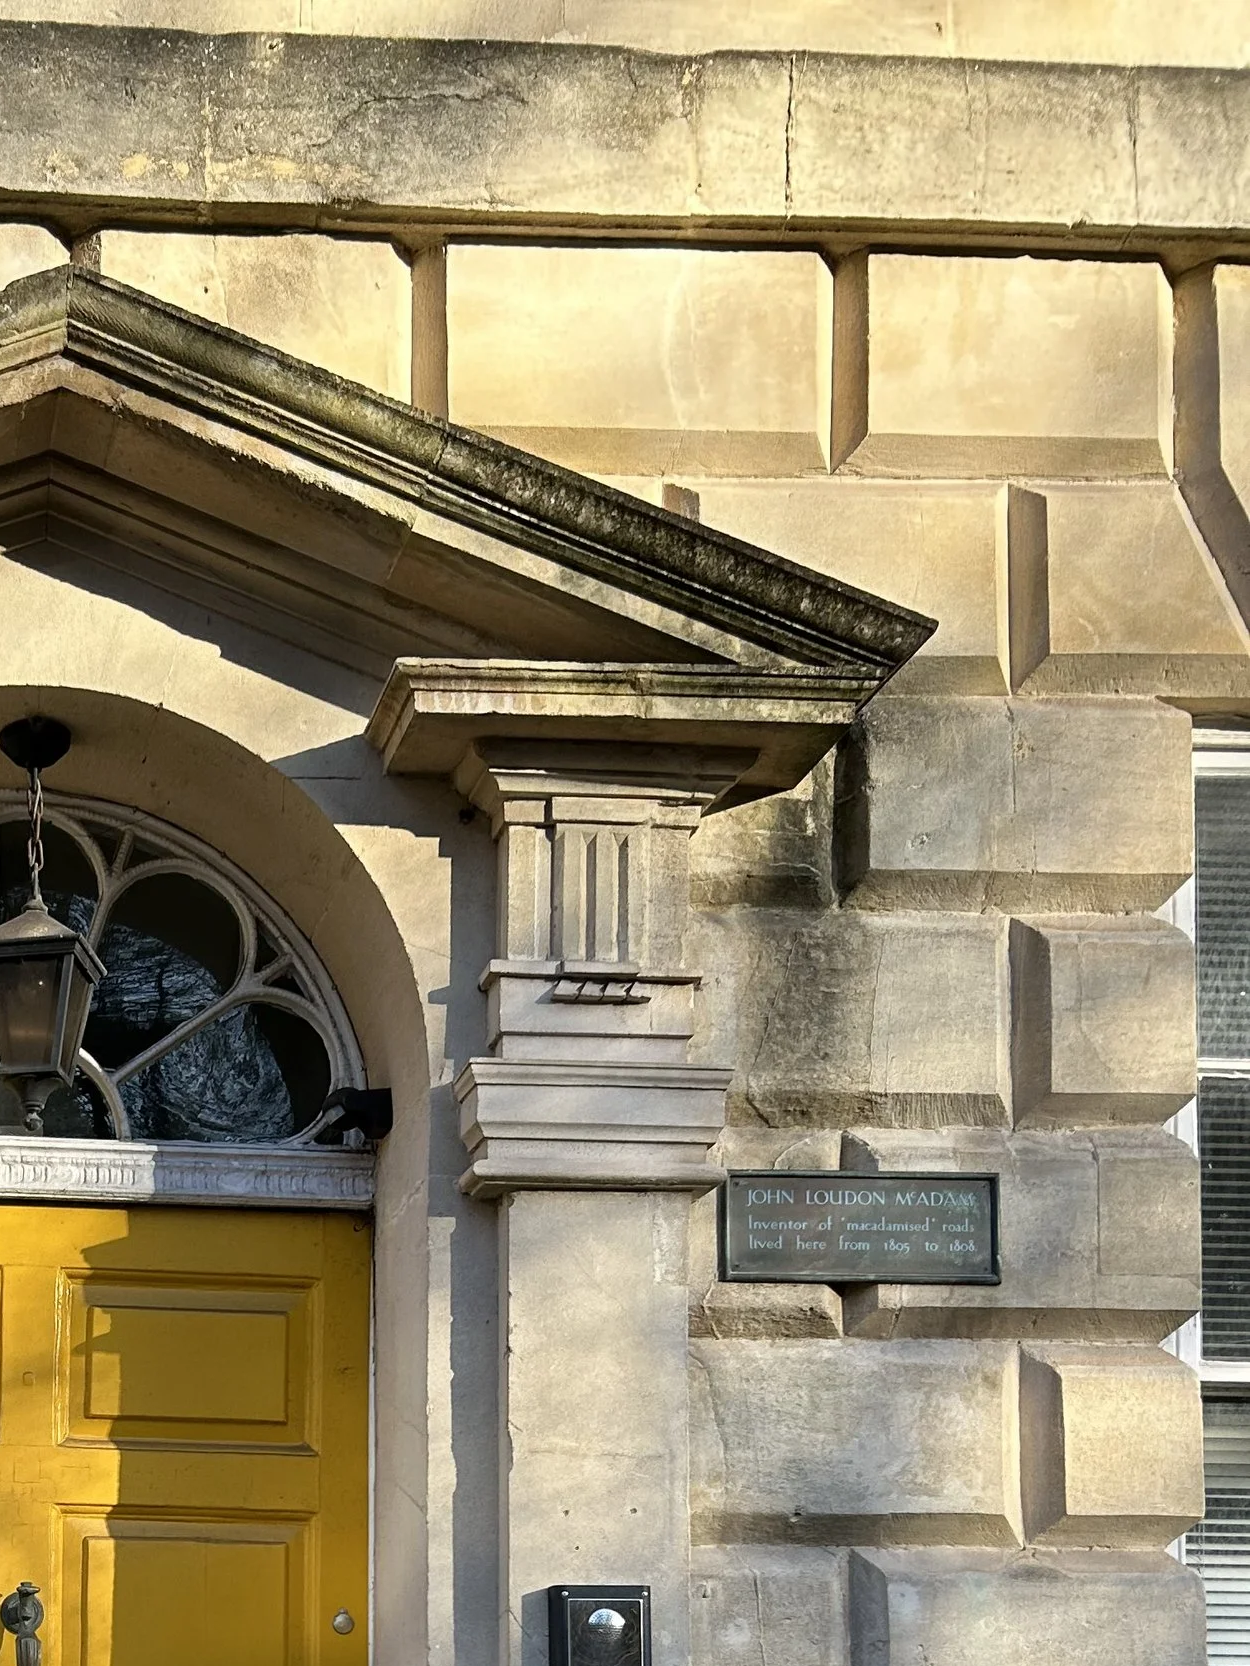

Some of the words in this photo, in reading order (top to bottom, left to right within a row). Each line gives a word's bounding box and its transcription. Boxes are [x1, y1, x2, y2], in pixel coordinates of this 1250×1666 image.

[746, 1189, 795, 1207] JOHN
[805, 1190, 886, 1206] LOUDON
[748, 1214, 808, 1231] Inventor
[818, 1215, 832, 1231] of
[942, 1218, 975, 1232] roads
[749, 1234, 783, 1250] lived
[796, 1234, 827, 1250] here
[838, 1235, 870, 1251] from
[883, 1238, 910, 1254] 1805
[924, 1241, 938, 1252] to
[950, 1239, 976, 1253] 1808
